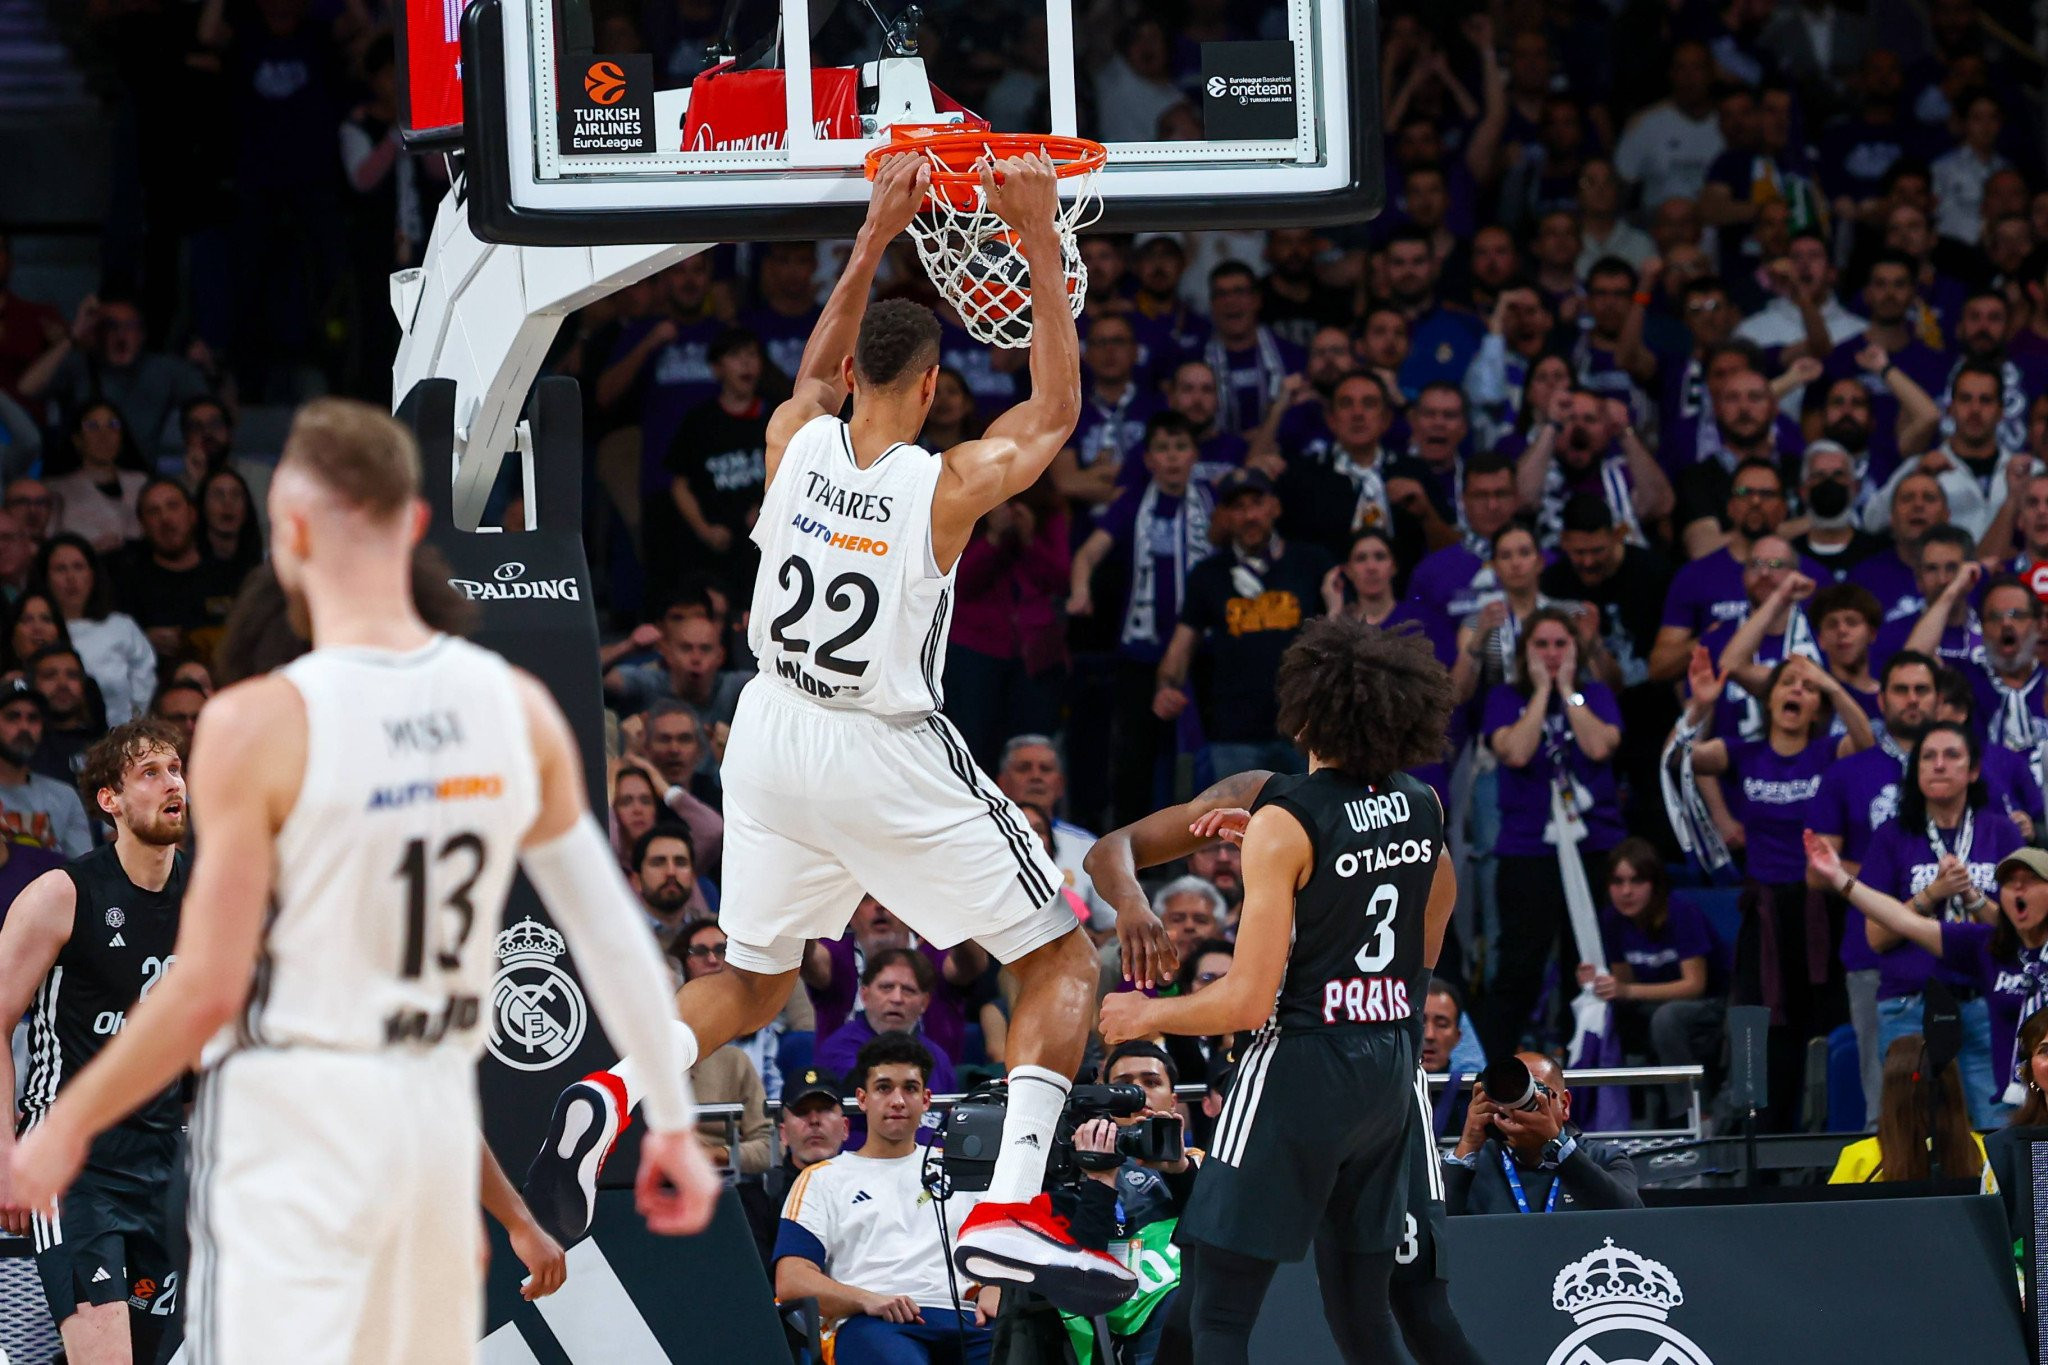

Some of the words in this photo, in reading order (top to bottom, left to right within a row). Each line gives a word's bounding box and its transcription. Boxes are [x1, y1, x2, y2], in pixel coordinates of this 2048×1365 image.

[1230, 83, 1292, 96] oneteam
[573, 107, 640, 121] TURKISH
[574, 122, 642, 135] AIRLINES
[573, 137, 643, 150] EuroLeague
[792, 513, 889, 556] AUTOHERO
[770, 554, 880, 677] 22
[1344, 791, 1411, 833] WARD
[1335, 838, 1432, 878] O'TACOS
[392, 832, 488, 980] 13
[1354, 883, 1399, 973] 3
[1322, 977, 1411, 1024] PARIS
